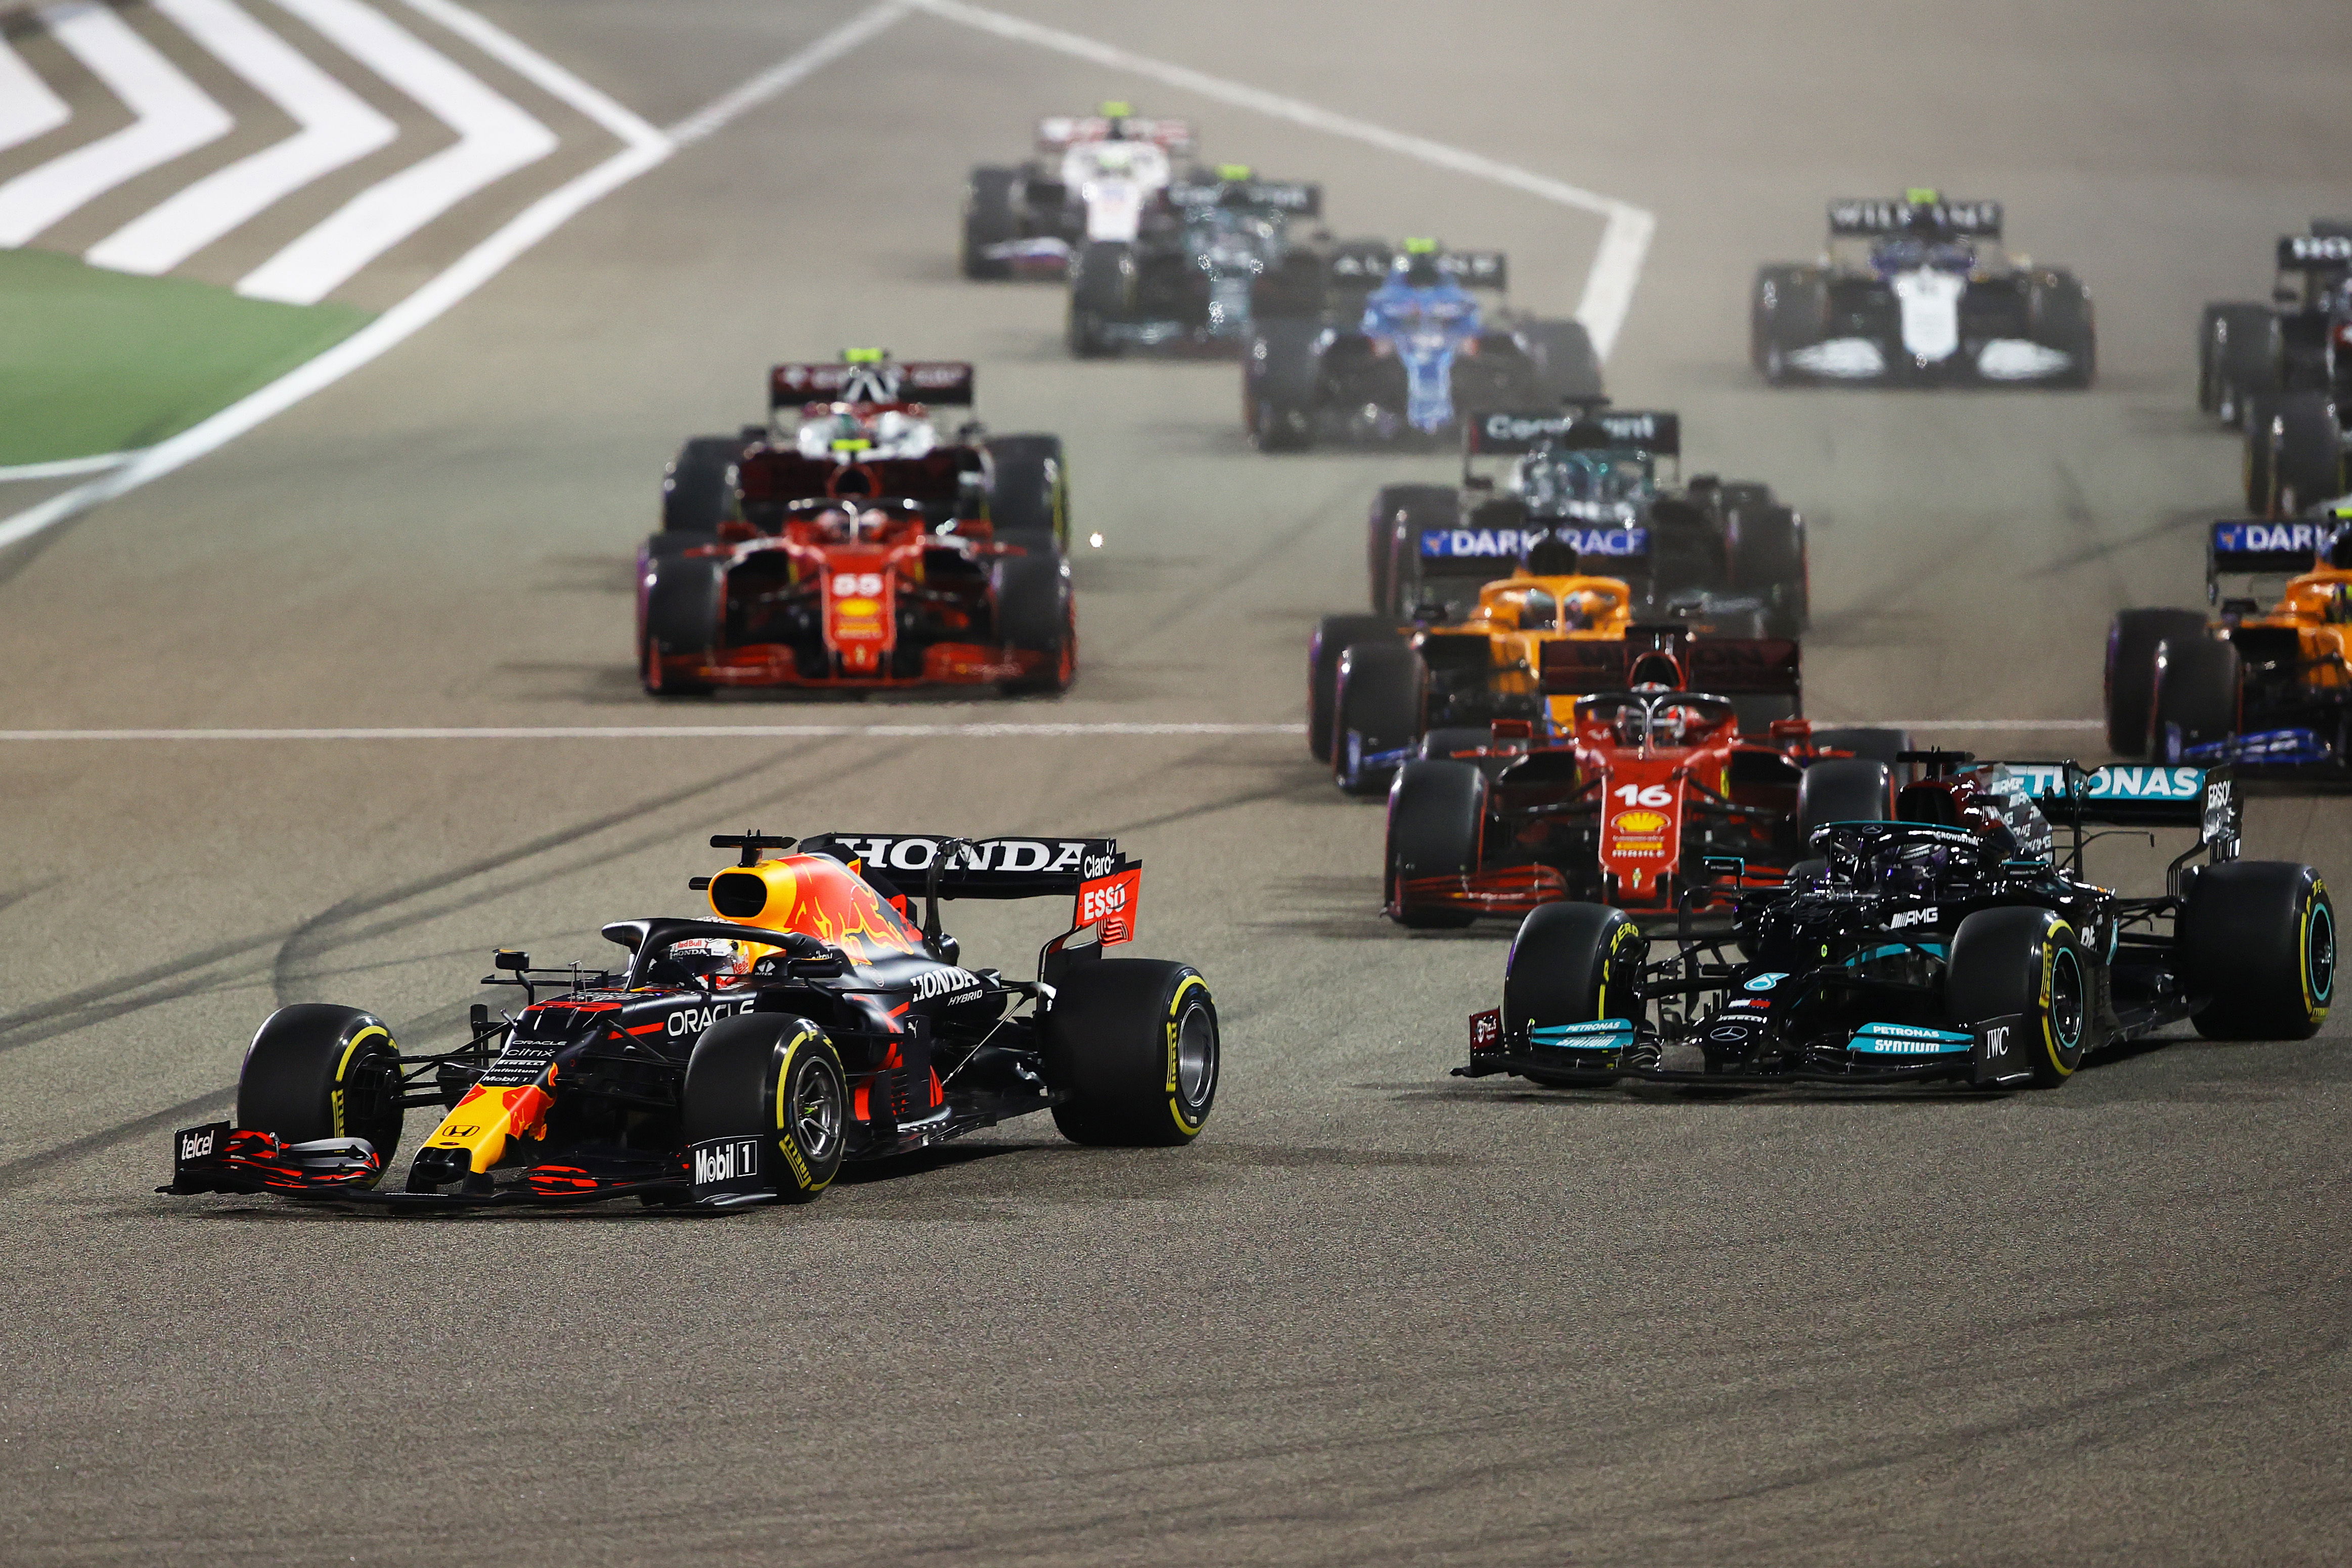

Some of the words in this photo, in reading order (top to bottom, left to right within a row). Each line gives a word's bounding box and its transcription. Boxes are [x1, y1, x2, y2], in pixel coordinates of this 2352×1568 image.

[1614, 784, 1673, 808] 16
[834, 838, 1087, 872] HONDA
[1084, 854, 1112, 879] Claro
[1903, 907, 1938, 926] AMG
[1610, 922, 1639, 956] ZERO
[910, 966, 980, 1003] HONDA
[947, 989, 983, 1006] HYBRID
[1565, 1021, 1621, 1033] PETRONAS
[1873, 1025, 1940, 1037] PETRONAS
[506, 1048, 556, 1057] citrix
[1986, 1026, 2009, 1059] IWC
[181, 1130, 214, 1160] telcel
[695, 1143, 734, 1186] Mobil
